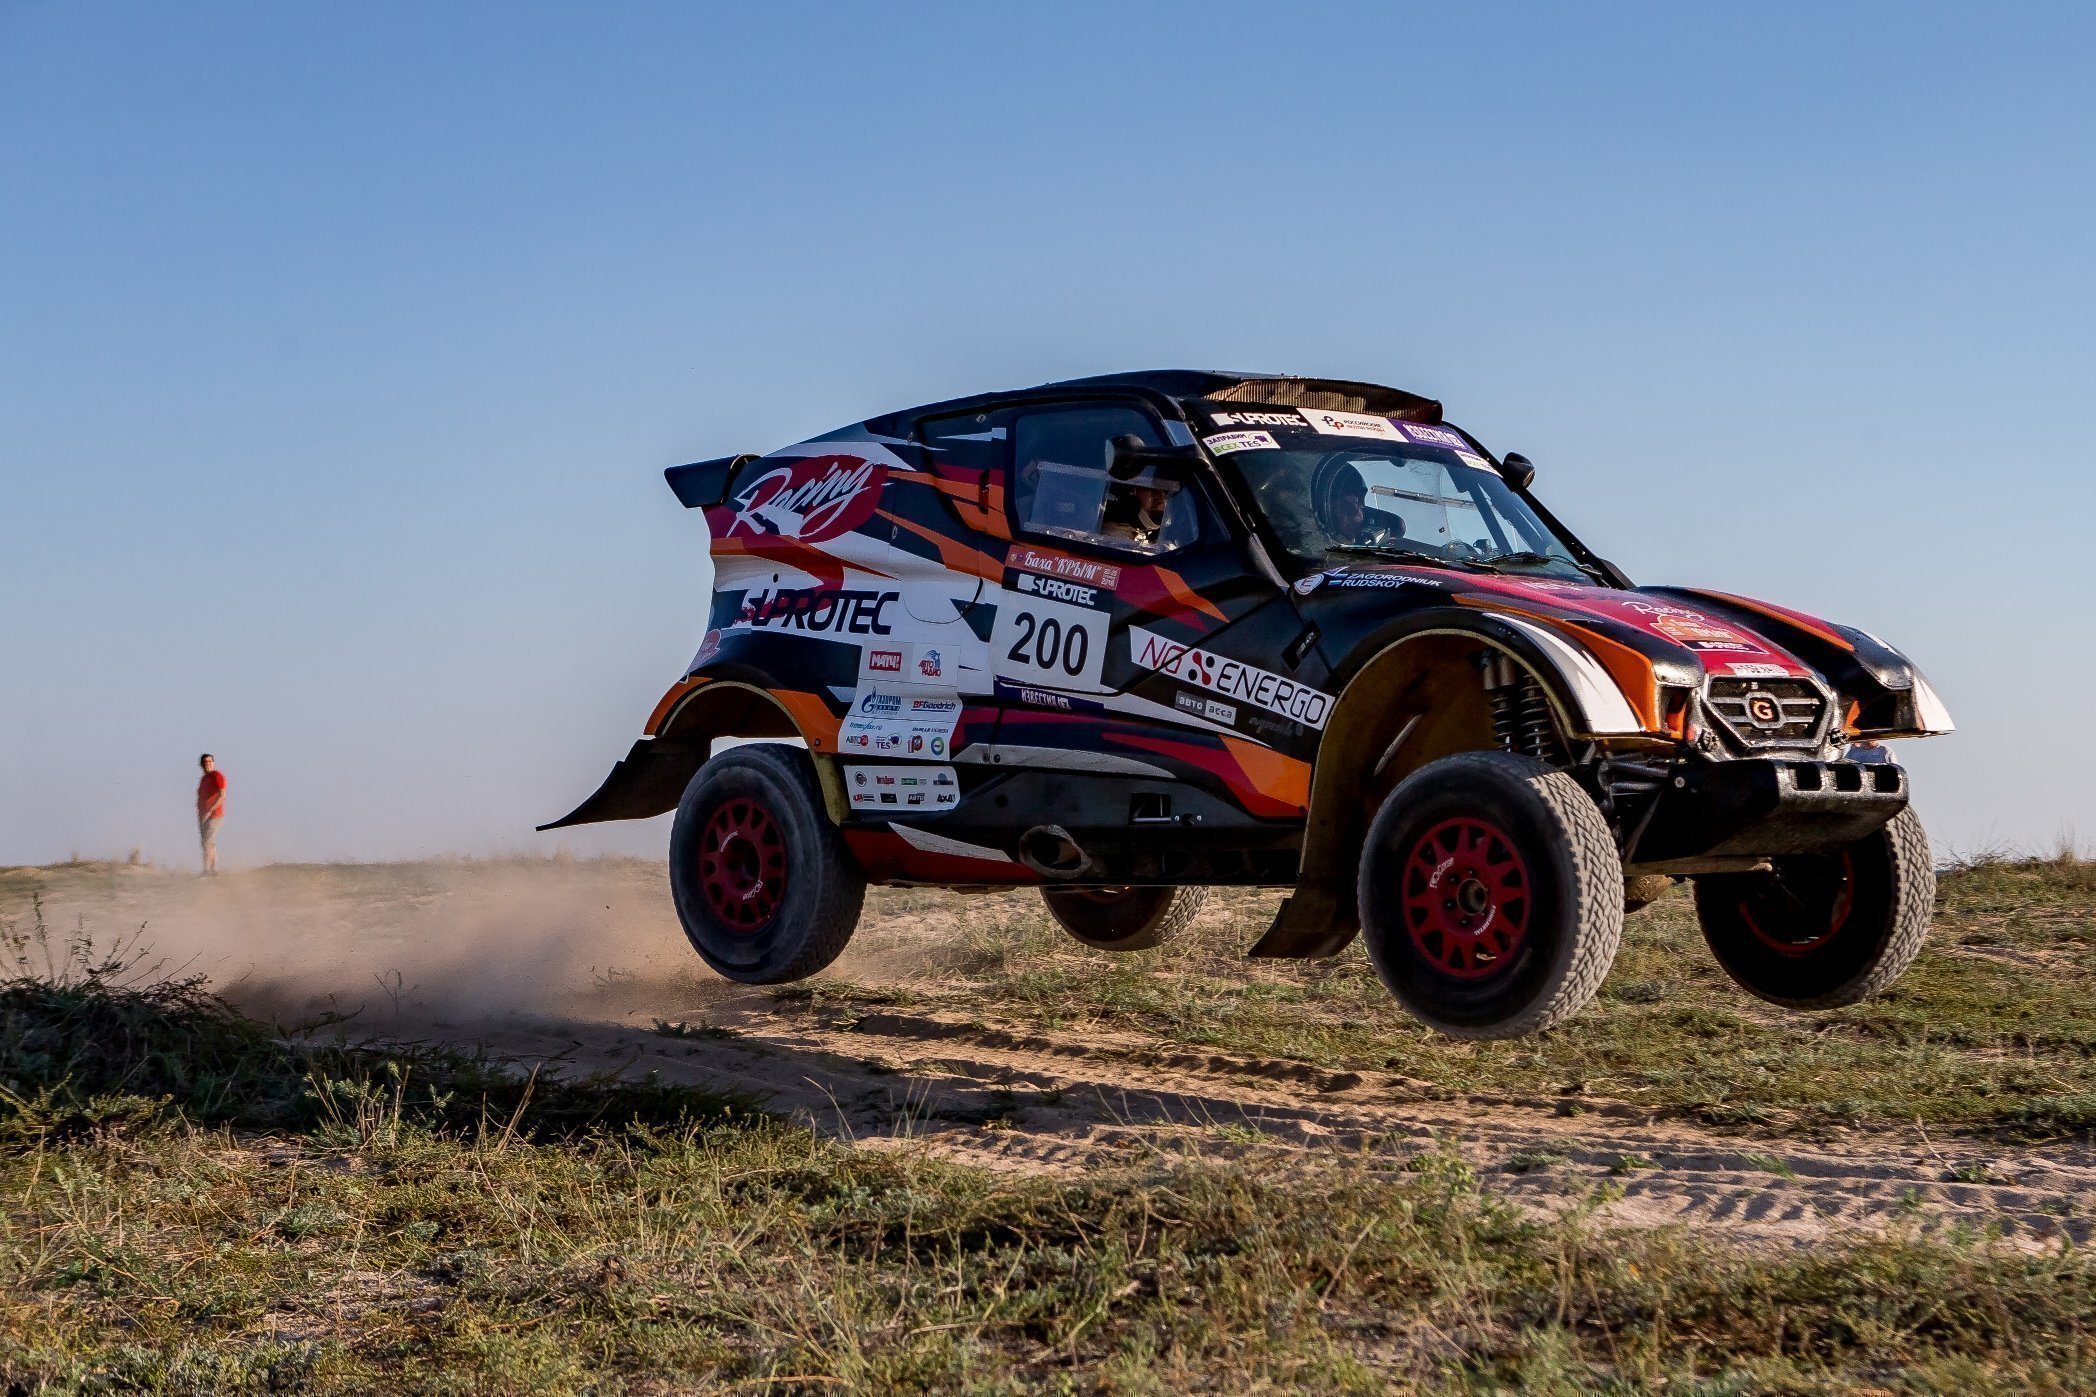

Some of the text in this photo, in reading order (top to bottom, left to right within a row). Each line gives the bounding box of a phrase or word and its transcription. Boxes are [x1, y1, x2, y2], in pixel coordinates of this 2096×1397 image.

[1223, 412, 1308, 427] SUPROTEC
[1207, 433, 1246, 445] ЗАПРАВИМ
[1213, 440, 1261, 453] ВСЕХ TES
[725, 461, 882, 539] Racing
[1024, 551, 1053, 571] Баха
[1341, 579, 1405, 589] RUDSKOY
[1347, 573, 1443, 587] ZAGORODNIUK
[1032, 577, 1098, 606] SUPROTEC
[734, 585, 900, 636] SUPROTEC
[1007, 611, 1089, 677] 200
[871, 654, 900, 669] МАТЧ!
[918, 660, 935, 668] АВТО
[921, 668, 942, 677] РАДИО
[1216, 662, 1327, 725] ENERGO
[912, 701, 957, 710] BFGoodrich
[1179, 697, 1233, 719] авто асса
[1752, 701, 1774, 720] G
[876, 741, 890, 750] TES
